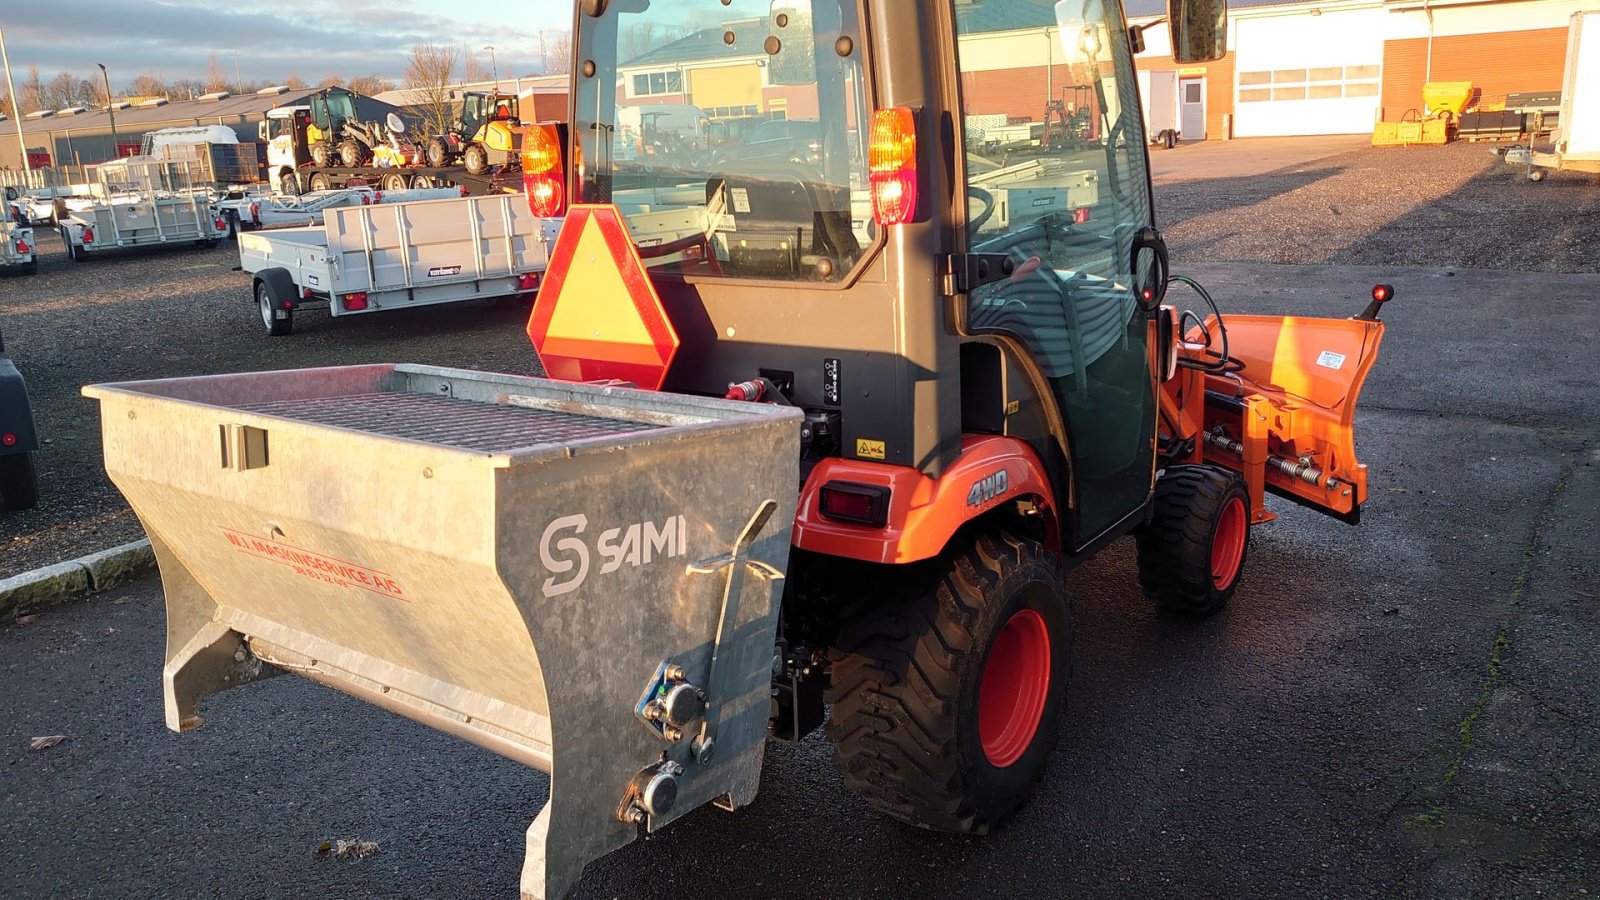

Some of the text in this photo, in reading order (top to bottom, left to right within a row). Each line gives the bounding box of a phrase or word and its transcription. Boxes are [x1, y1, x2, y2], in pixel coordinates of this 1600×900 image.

[967, 469, 1008, 506] 4WD
[251, 540, 372, 585] MASKINSERVICE
[372, 575, 402, 594] A/S
[597, 514, 686, 575] SAMI
